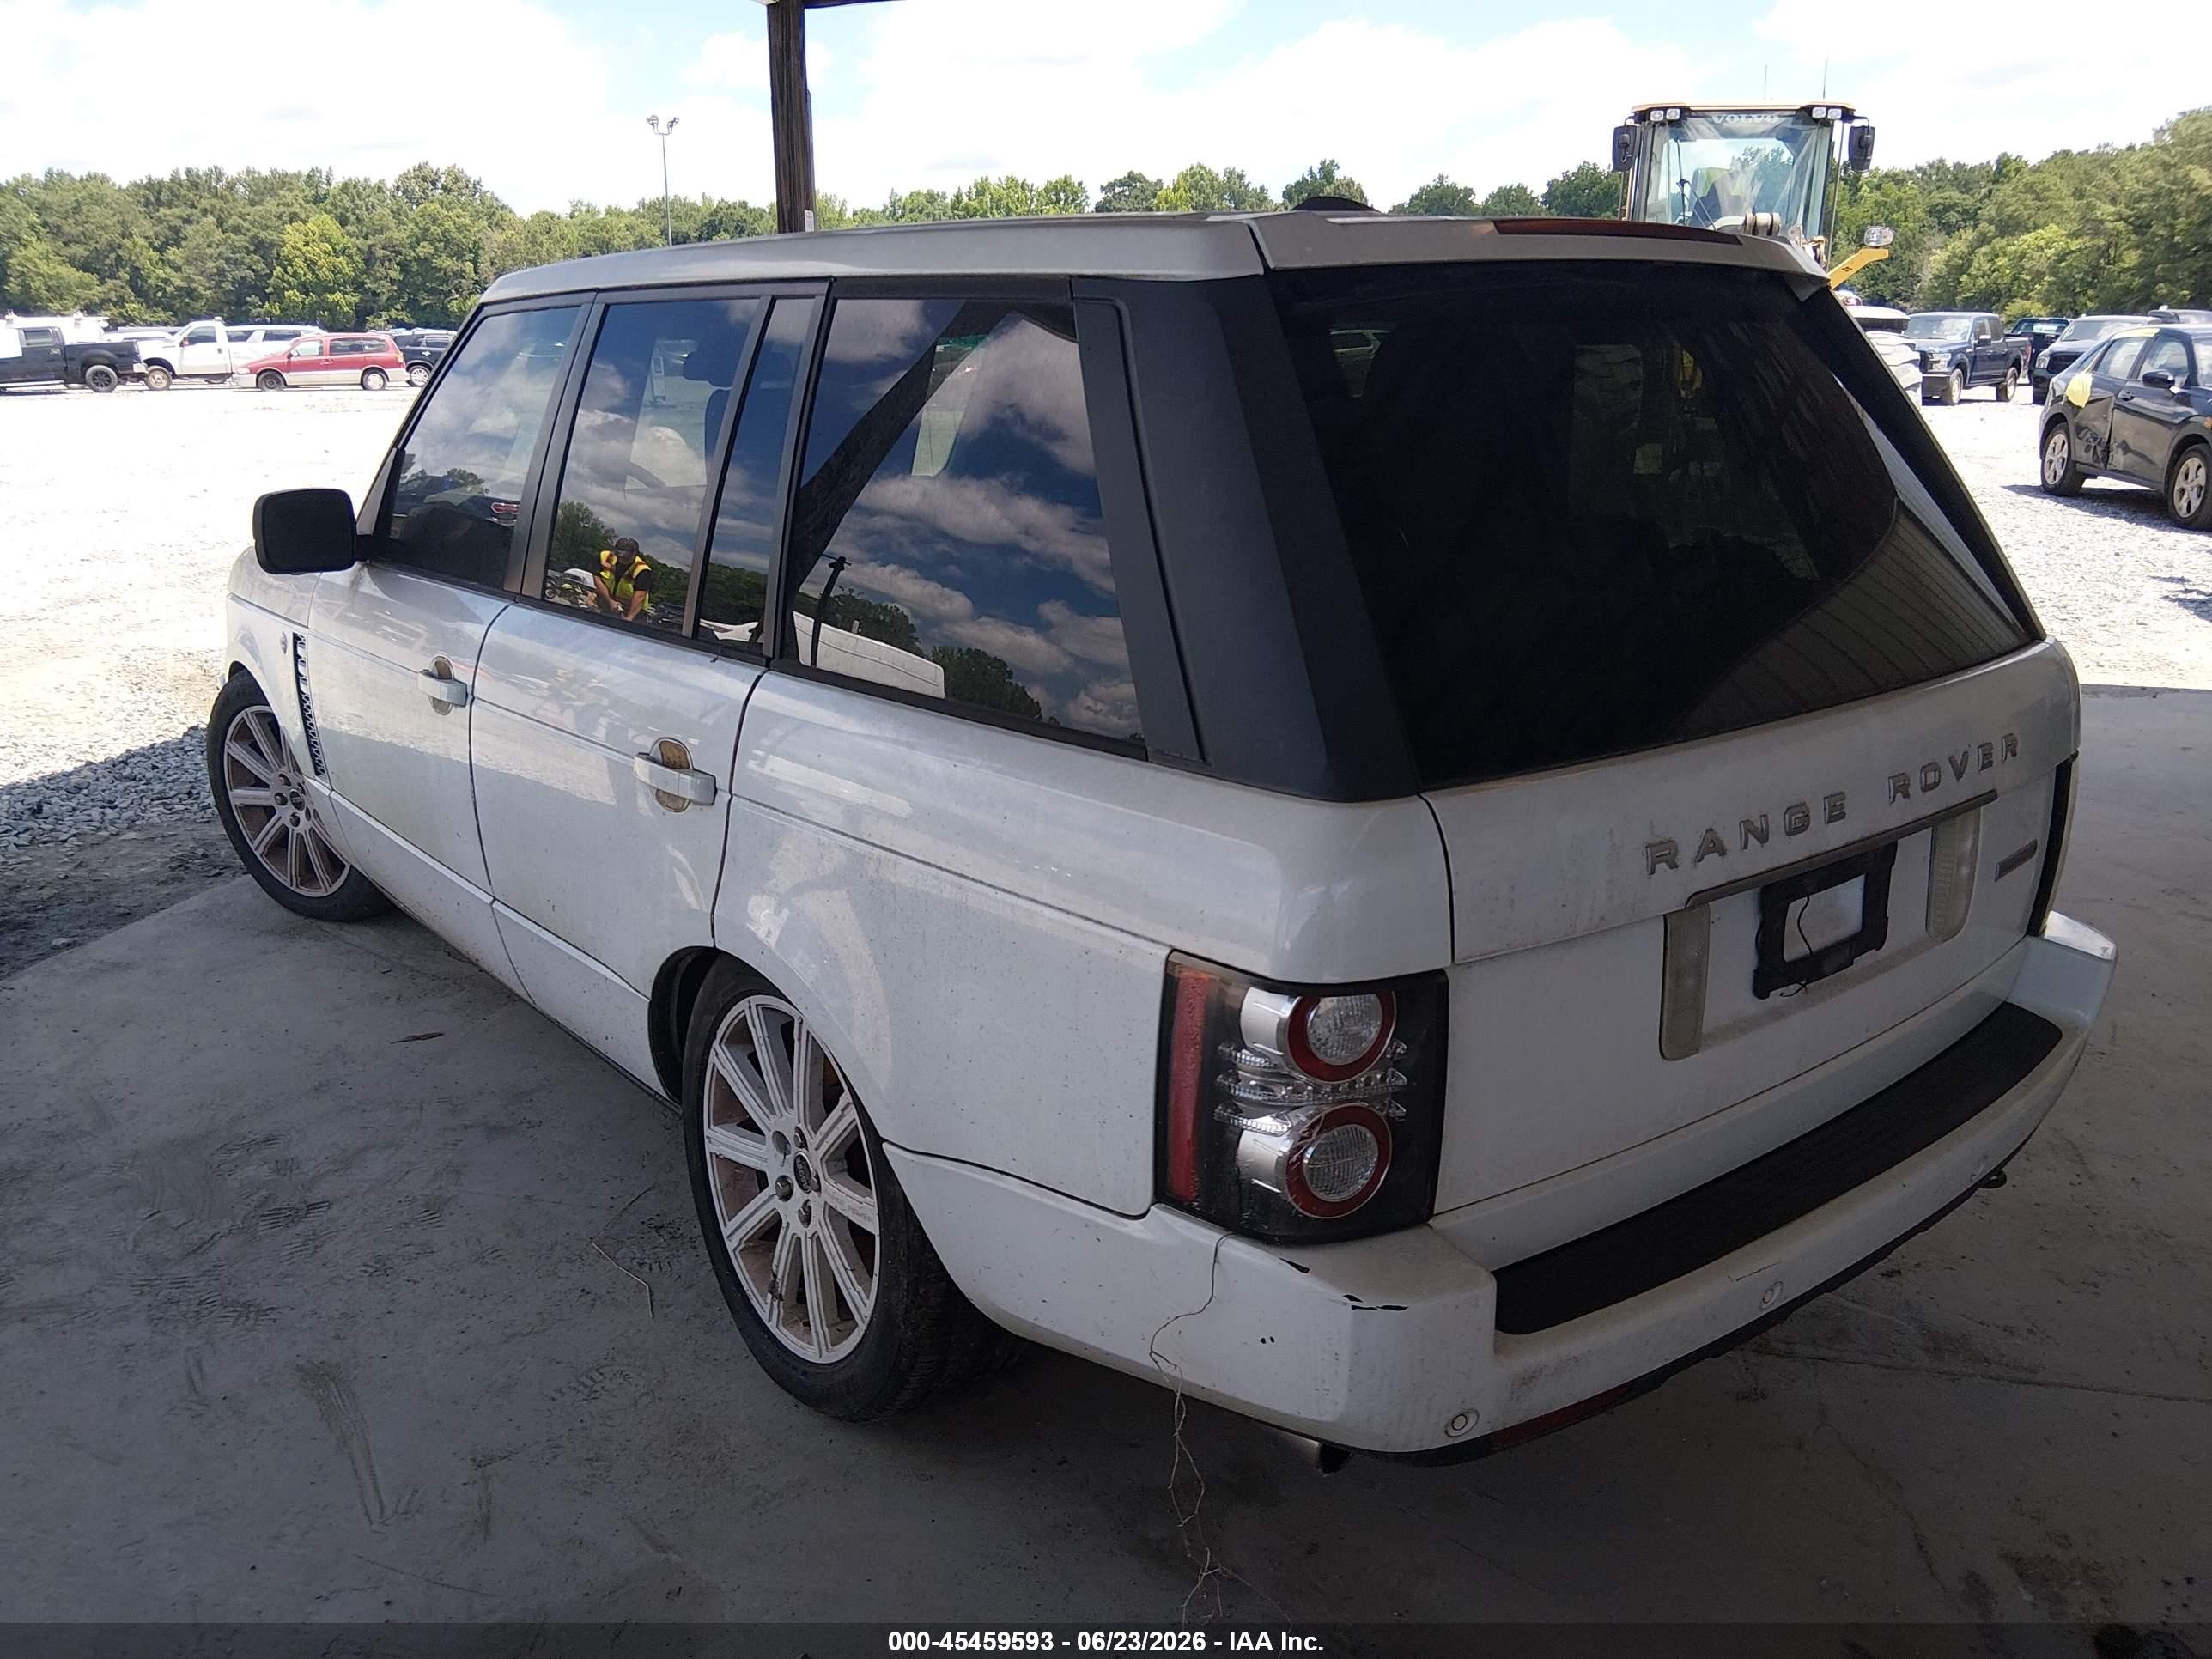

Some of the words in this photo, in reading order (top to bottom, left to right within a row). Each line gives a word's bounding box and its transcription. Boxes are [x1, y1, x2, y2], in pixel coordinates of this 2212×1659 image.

[1711, 113, 1779, 124] VOLVO
[1646, 792, 1846, 875] RANGE
[1889, 733, 2018, 803] ROVER
